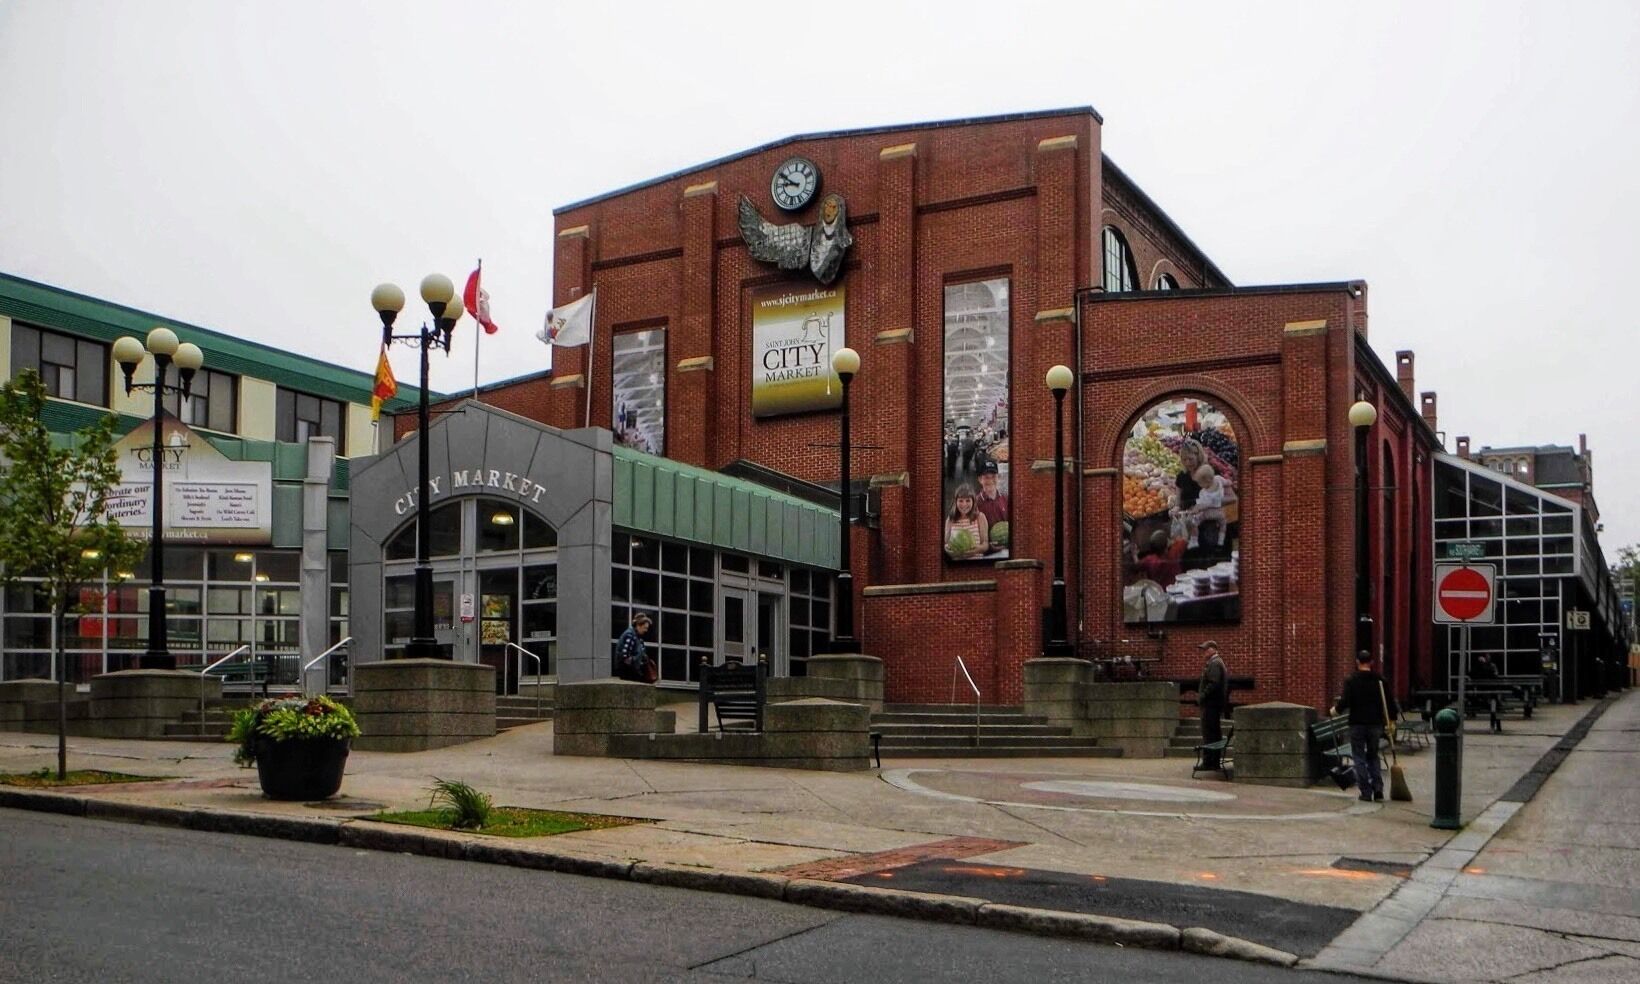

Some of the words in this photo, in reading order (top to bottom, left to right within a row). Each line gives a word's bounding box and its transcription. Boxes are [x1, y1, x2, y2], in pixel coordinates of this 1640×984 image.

[760, 288, 837, 308] www.sjcitymarket.ca
[766, 340, 783, 349] SAINT
[783, 338, 801, 347] JOHN
[763, 342, 826, 370] CITY
[765, 366, 822, 383] MARKET
[137, 448, 184, 463] CTY
[134, 485, 151, 494] our
[453, 469, 546, 503] MARKET
[394, 476, 441, 515] CIY
